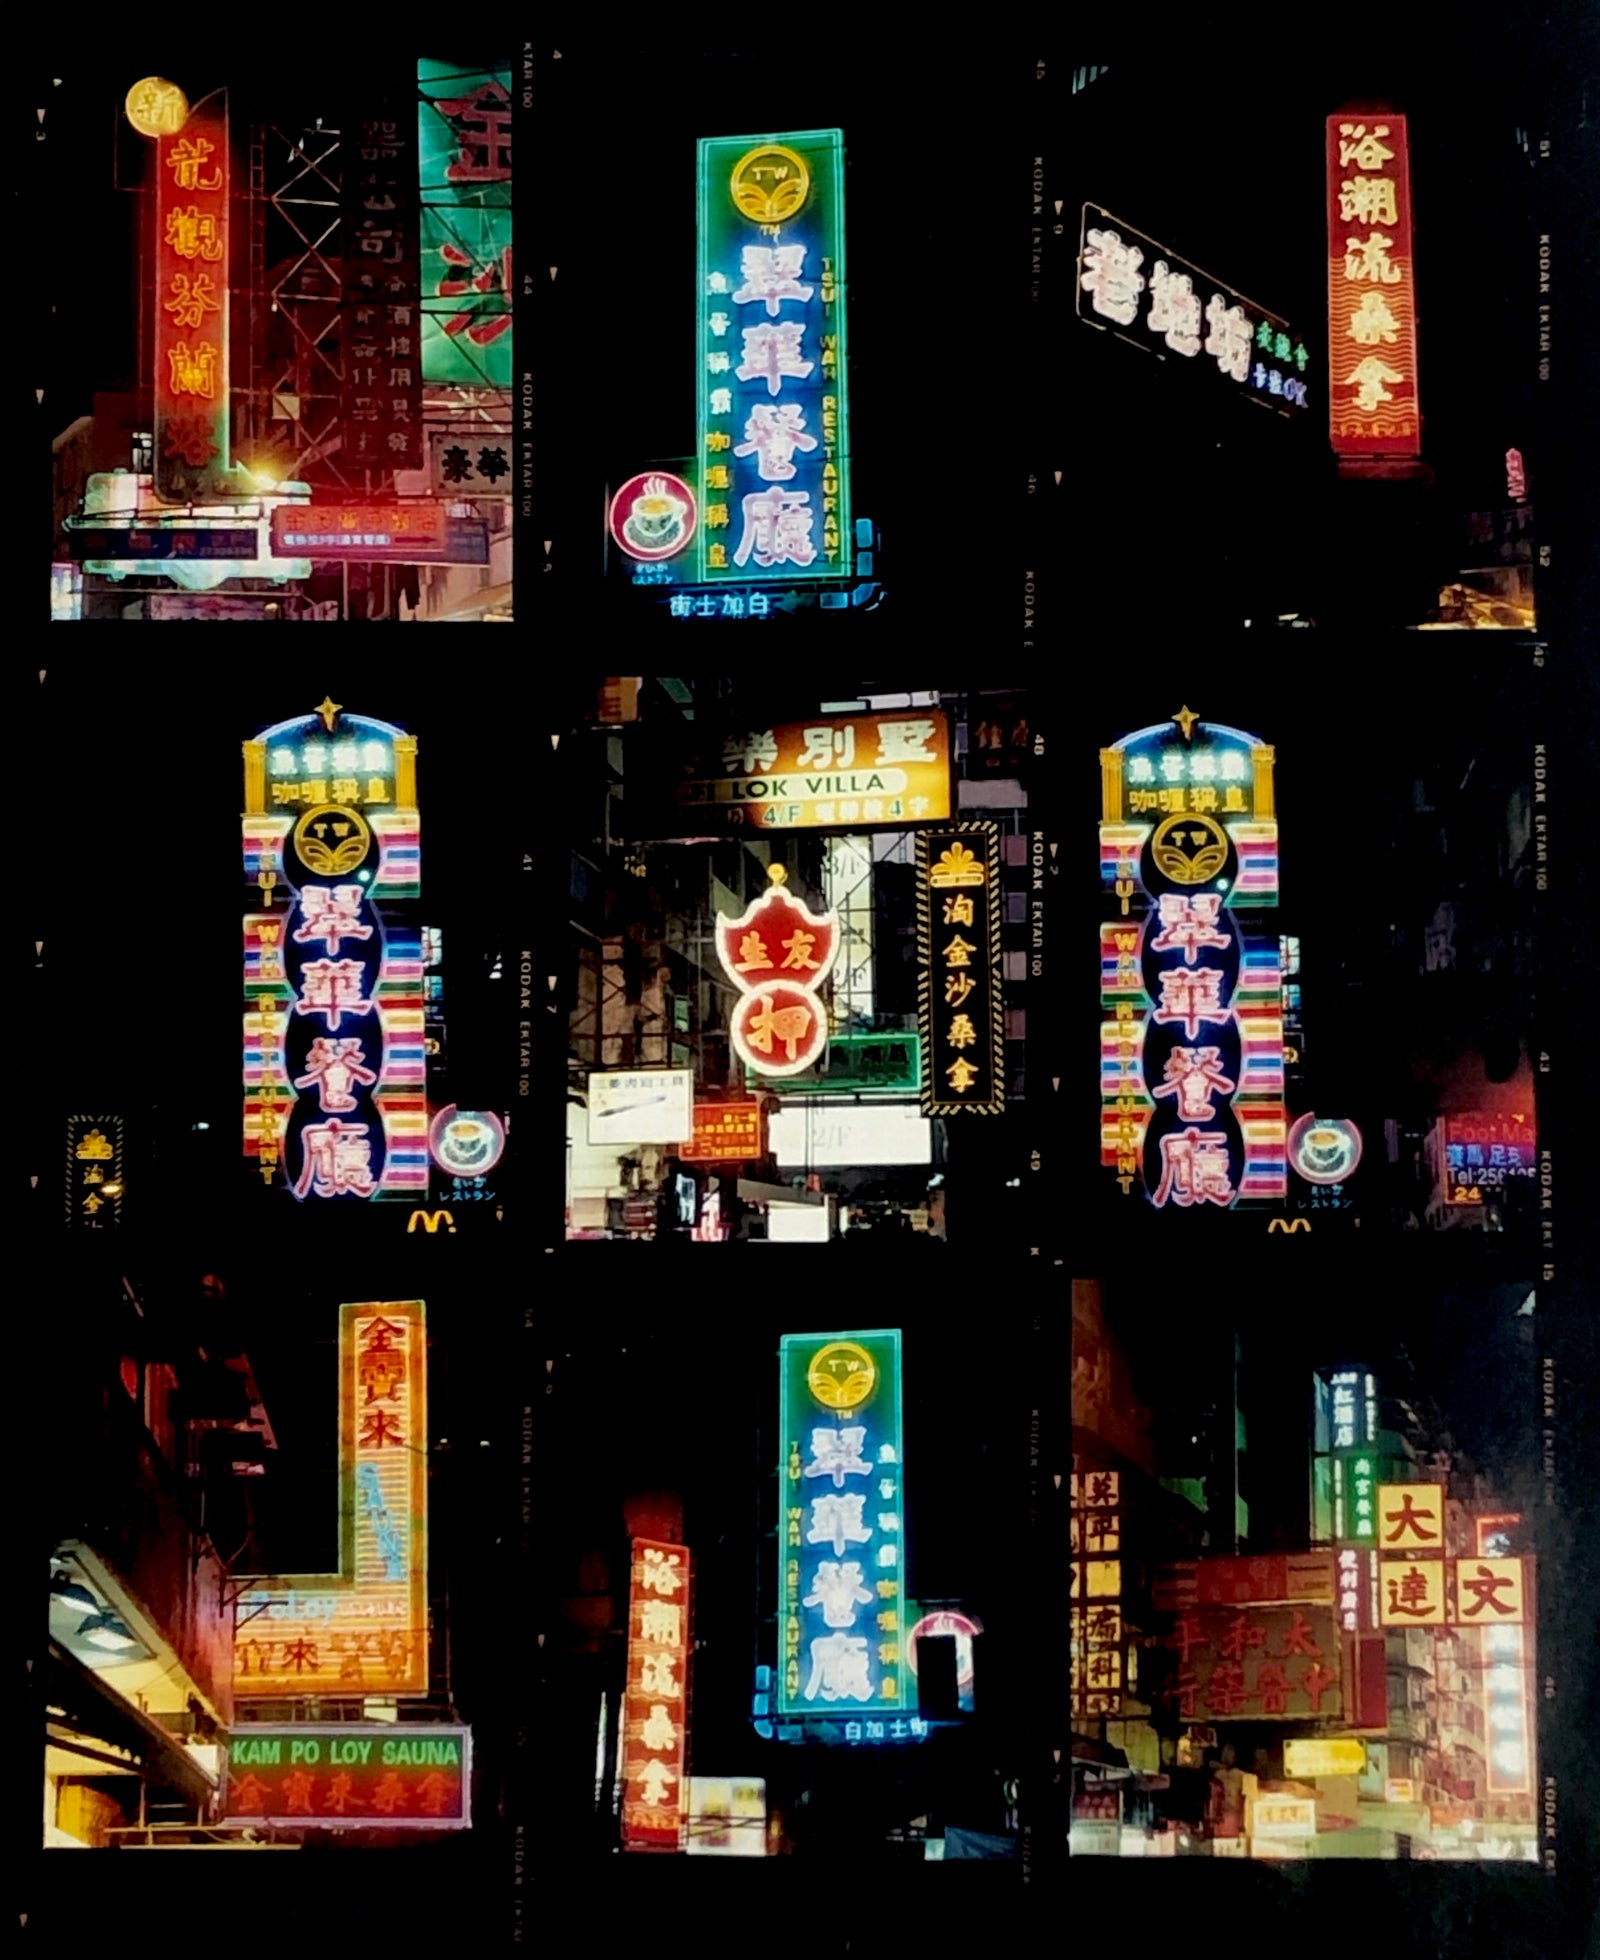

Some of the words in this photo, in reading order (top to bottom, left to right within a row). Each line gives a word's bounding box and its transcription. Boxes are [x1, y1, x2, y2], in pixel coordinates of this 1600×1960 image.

[136, 81, 178, 128] 新
[1032, 157, 1043, 215] KODAK
[1539, 234, 1550, 293] KODAK
[522, 373, 533, 430] KODAK
[732, 245, 817, 567] 翠華餐廳
[823, 396, 838, 565] RESTAURANT
[1024, 571, 1035, 629] KODAK
[733, 780, 788, 798] LOK
[806, 773, 885, 793] VILLA
[1534, 744, 1546, 804] KODAK
[763, 804, 799, 823] 4/F
[1535, 815, 1547, 861] EKTAR
[1032, 831, 1044, 889] KODAK
[1536, 866, 1548, 890] 100
[1032, 901, 1043, 947] EKTAR
[519, 950, 531, 1009] KODAK
[942, 894, 978, 1093] 淘金沙桑拿
[1031, 954, 1042, 976] 100
[293, 885, 379, 1199] 翠華餐廳
[519, 1021, 531, 1067] EKTAR
[747, 995, 811, 1061] 押
[1151, 893, 1237, 1208] 翠華餐廳
[519, 1073, 530, 1096] 100
[1541, 1150, 1551, 1209] KODAK
[1543, 1358, 1554, 1417] KODAK
[1385, 1494, 1438, 1543] 大
[803, 1427, 873, 1701] 翠華餐廳
[1387, 1567, 1437, 1617] 達
[1462, 1567, 1518, 1617] 文
[233, 1741, 280, 1764] KAM
[291, 1741, 319, 1764] PO
[330, 1741, 372, 1764] LOY
[382, 1741, 458, 1765] SAUNA
[1544, 1777, 1556, 1840] KODAK
